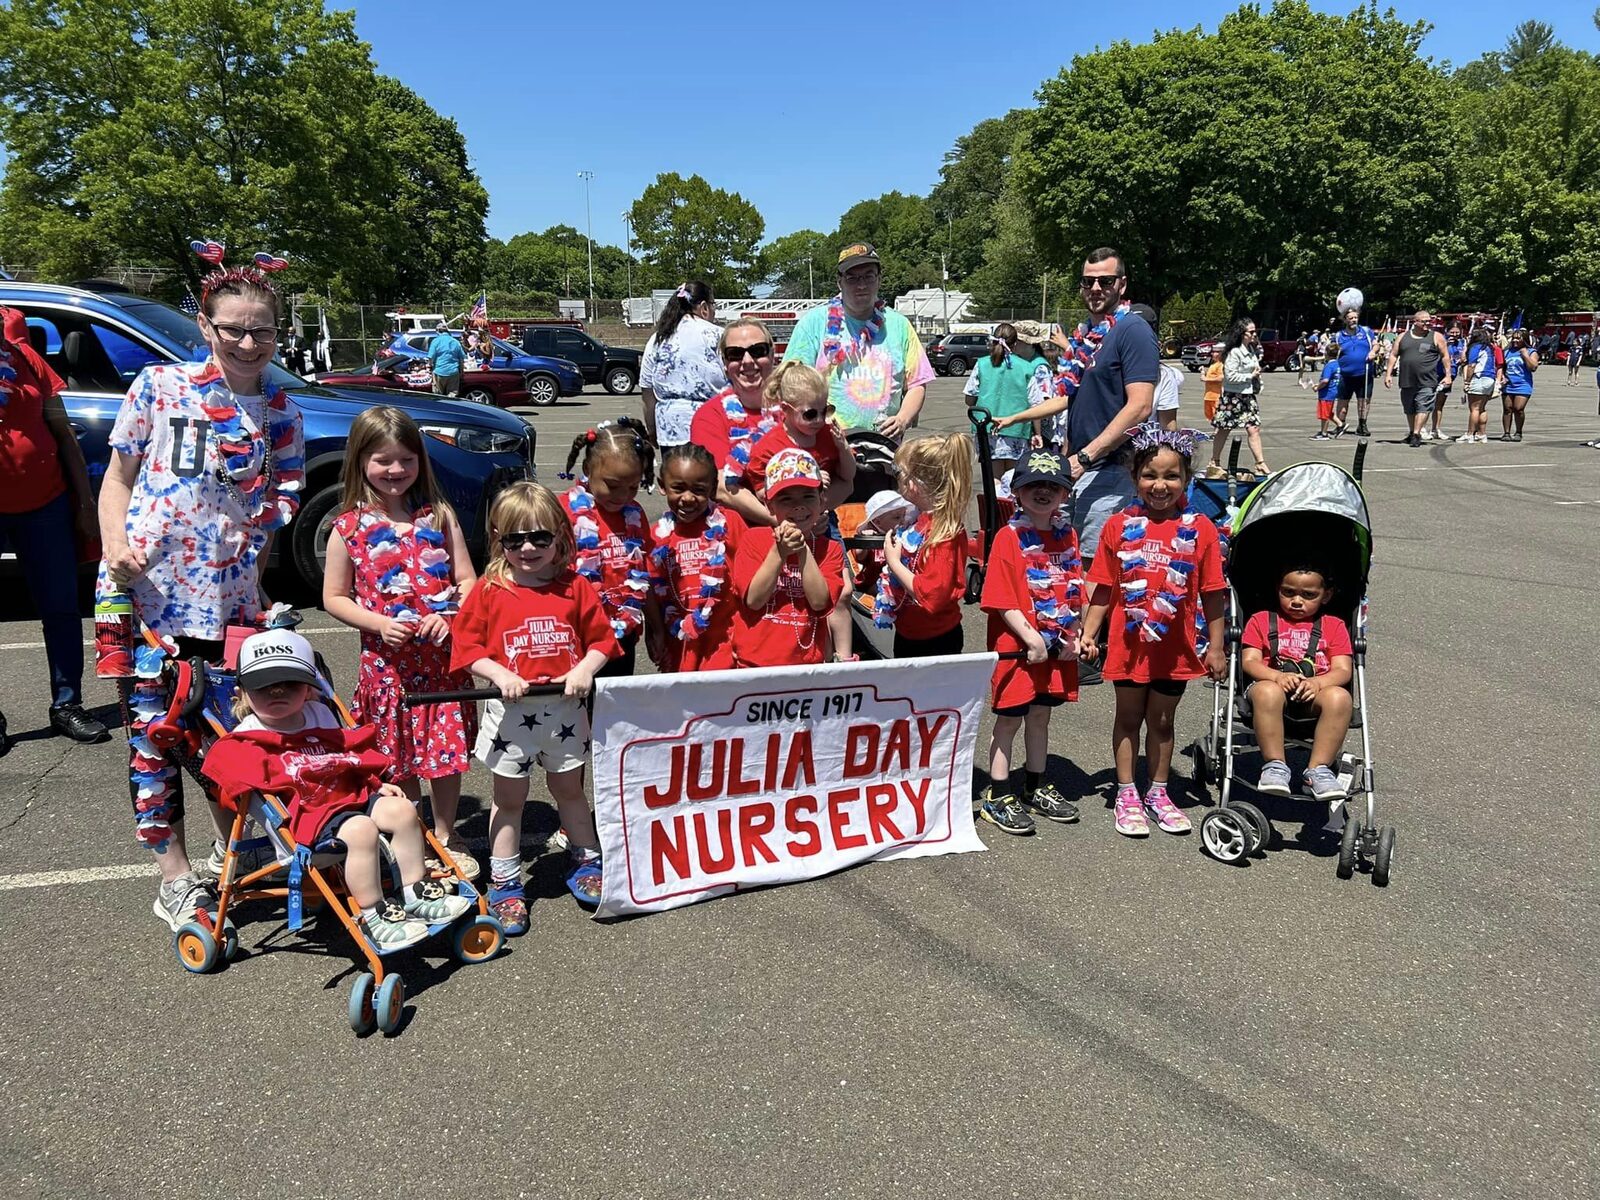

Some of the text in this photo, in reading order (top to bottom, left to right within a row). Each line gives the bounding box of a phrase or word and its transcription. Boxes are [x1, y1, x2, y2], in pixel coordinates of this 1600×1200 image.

[679, 541, 699, 552] JULIA
[1142, 542, 1160, 553] ULIA
[528, 620, 555, 633] JULIA
[513, 632, 570, 647] DAY NURSERY
[1290, 631, 1309, 641] JULIA
[254, 645, 293, 658] BOSS
[1291, 639, 1310, 651] NURS
[746, 692, 863, 723] SINCE 1917
[643, 714, 949, 809] JULIA DAY
[650, 777, 932, 887] NURSERY
